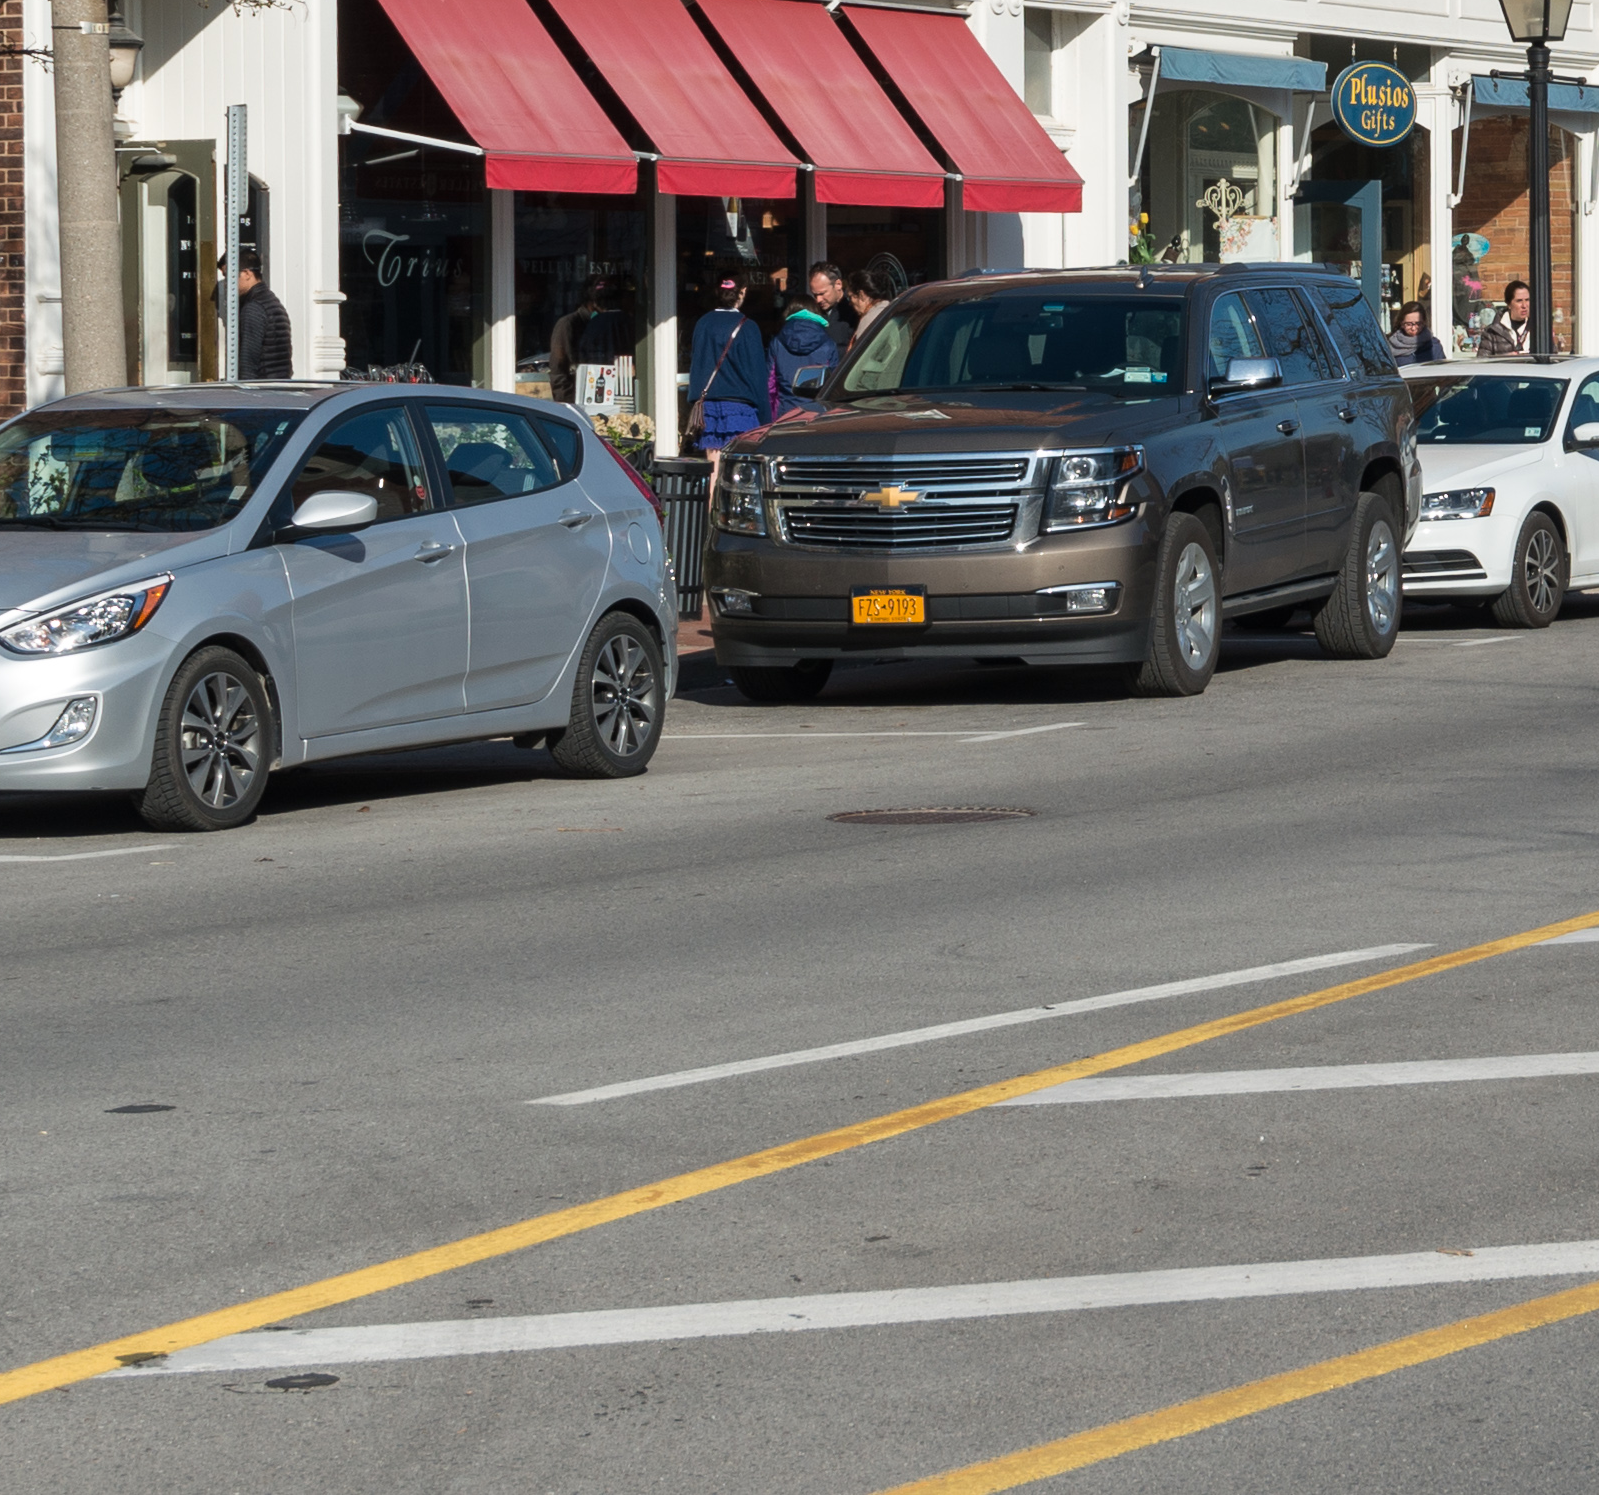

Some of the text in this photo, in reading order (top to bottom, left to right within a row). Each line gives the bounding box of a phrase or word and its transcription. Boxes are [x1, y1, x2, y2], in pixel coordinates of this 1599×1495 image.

[1350, 74, 1409, 108] Plusios
[1361, 108, 1395, 137] Gifts
[362, 228, 464, 287] Trius
